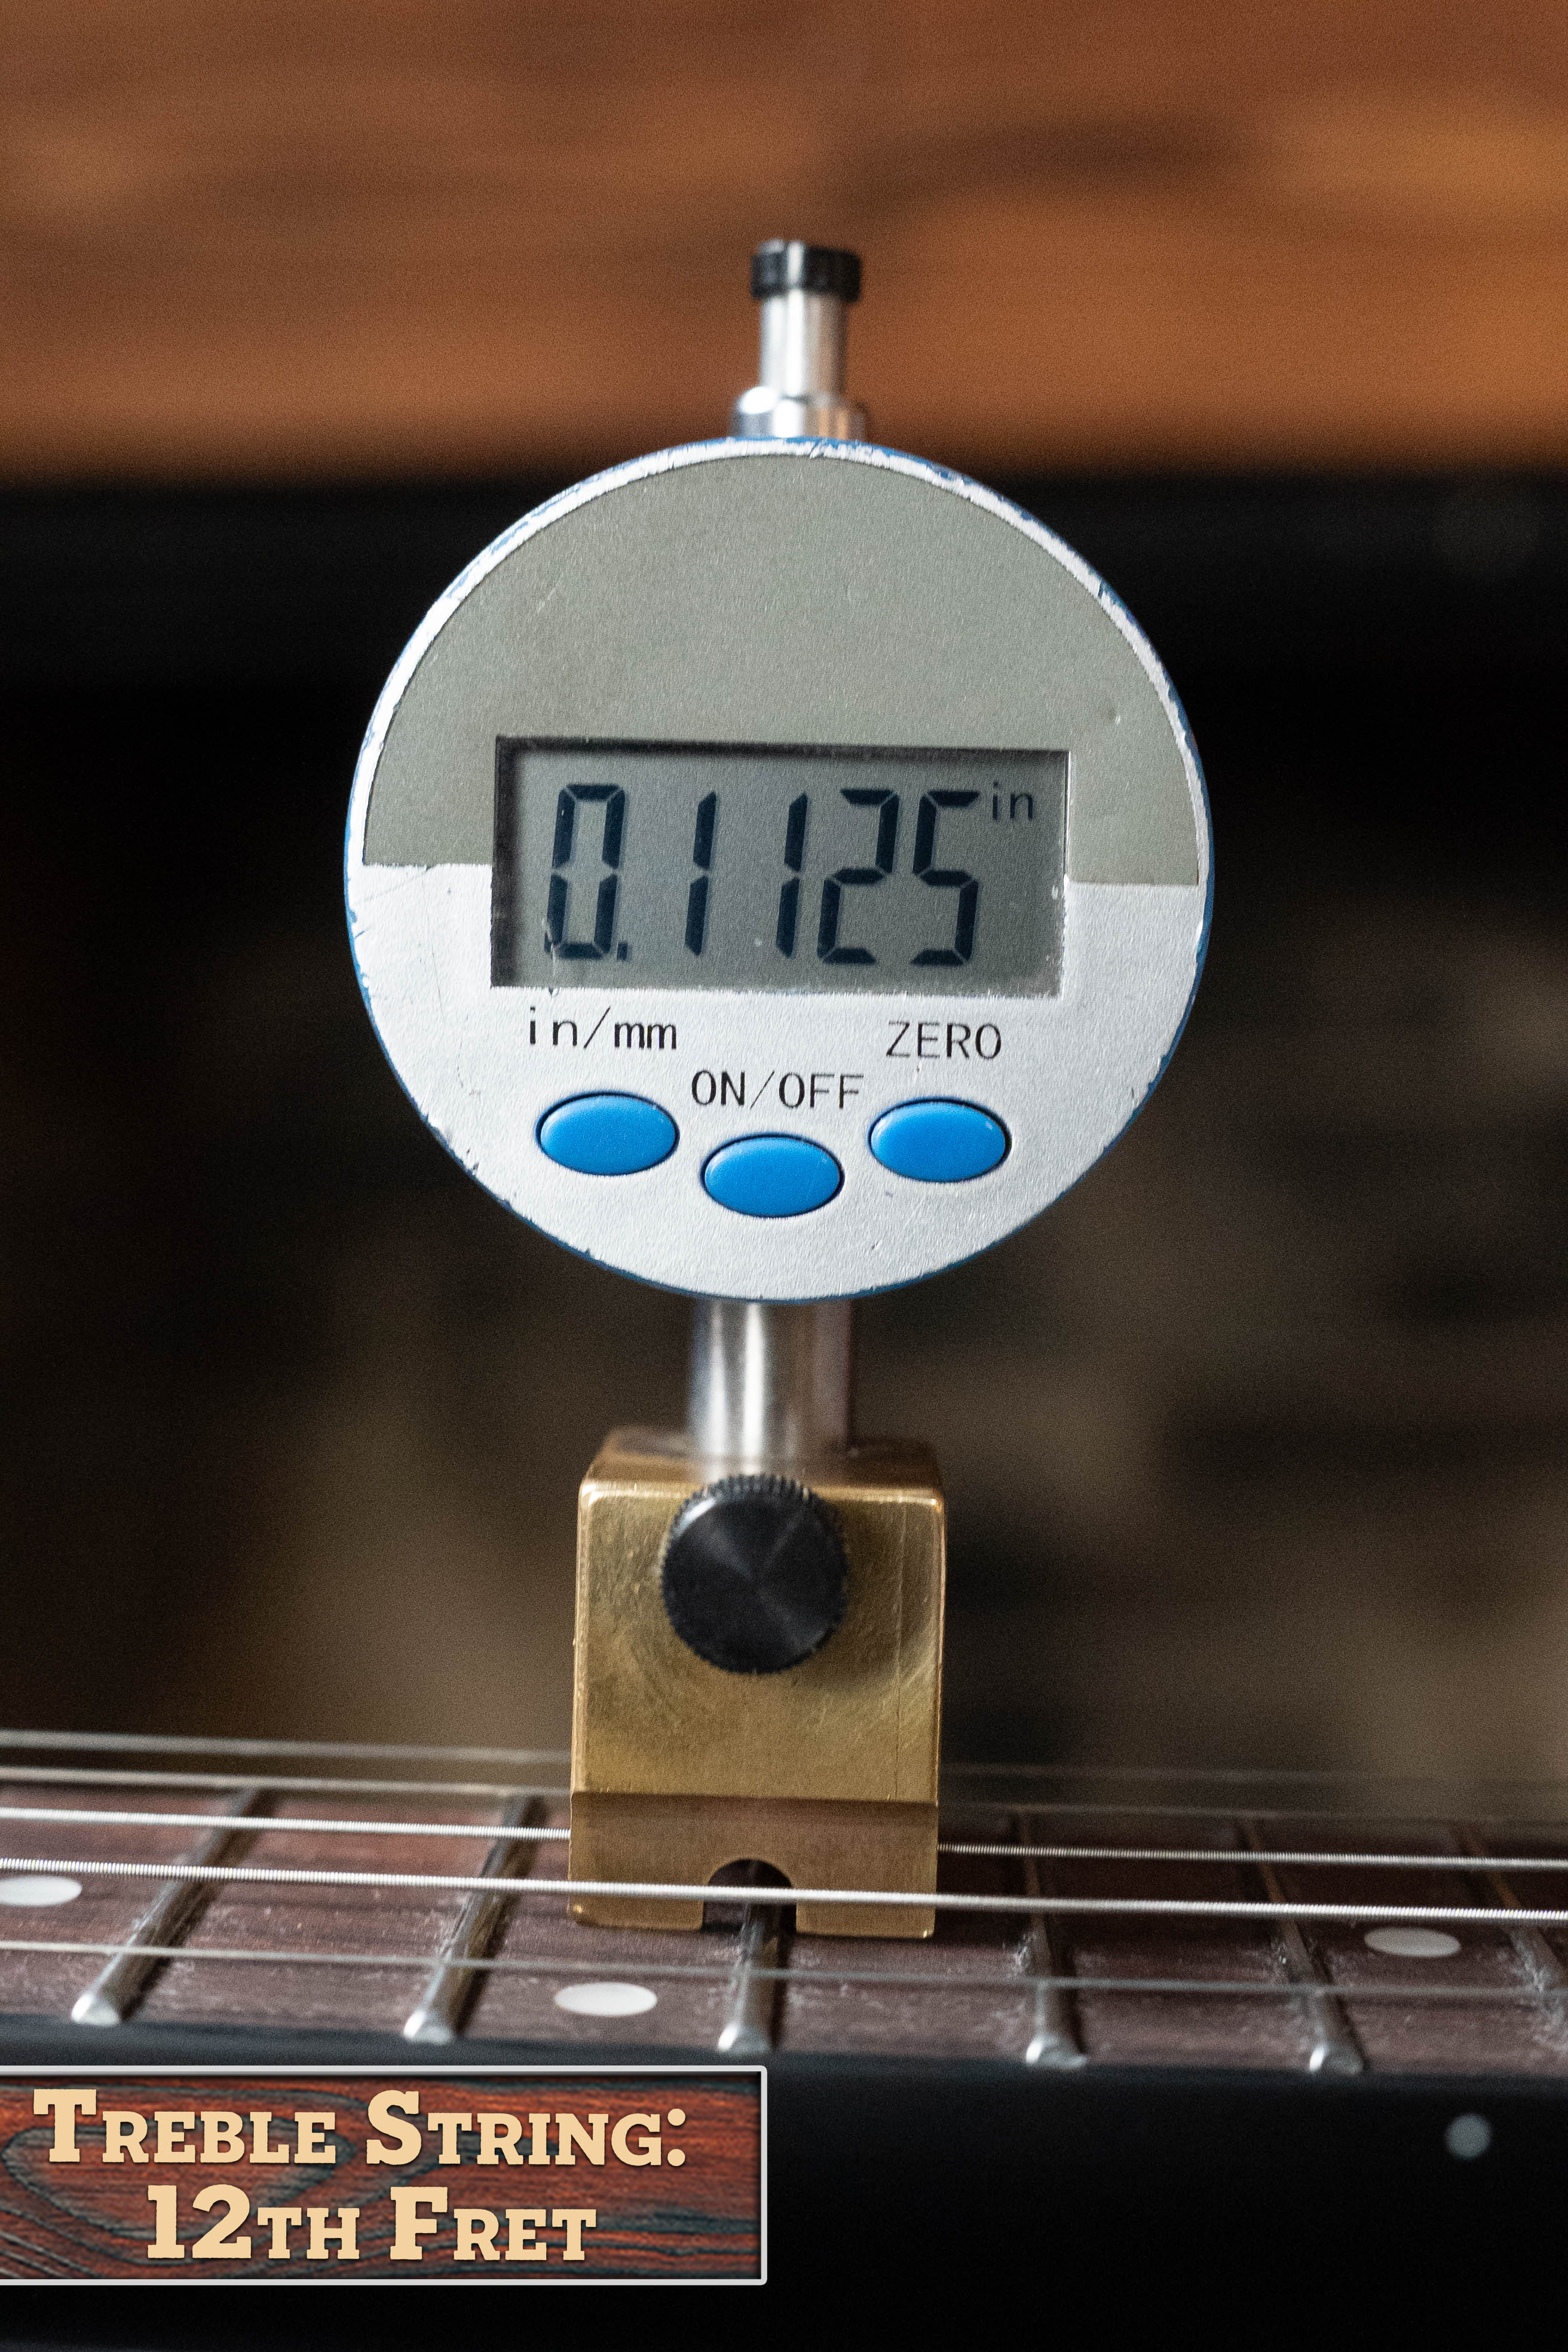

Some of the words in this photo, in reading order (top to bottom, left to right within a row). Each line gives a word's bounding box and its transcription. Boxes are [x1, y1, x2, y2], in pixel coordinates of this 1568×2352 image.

[544, 783, 979, 966] 0.1125
[991, 782, 1034, 820] in
[528, 1006, 678, 1051] in/mm
[885, 1019, 1003, 1060] ZERO
[691, 1069, 865, 1109] ON/OFF
